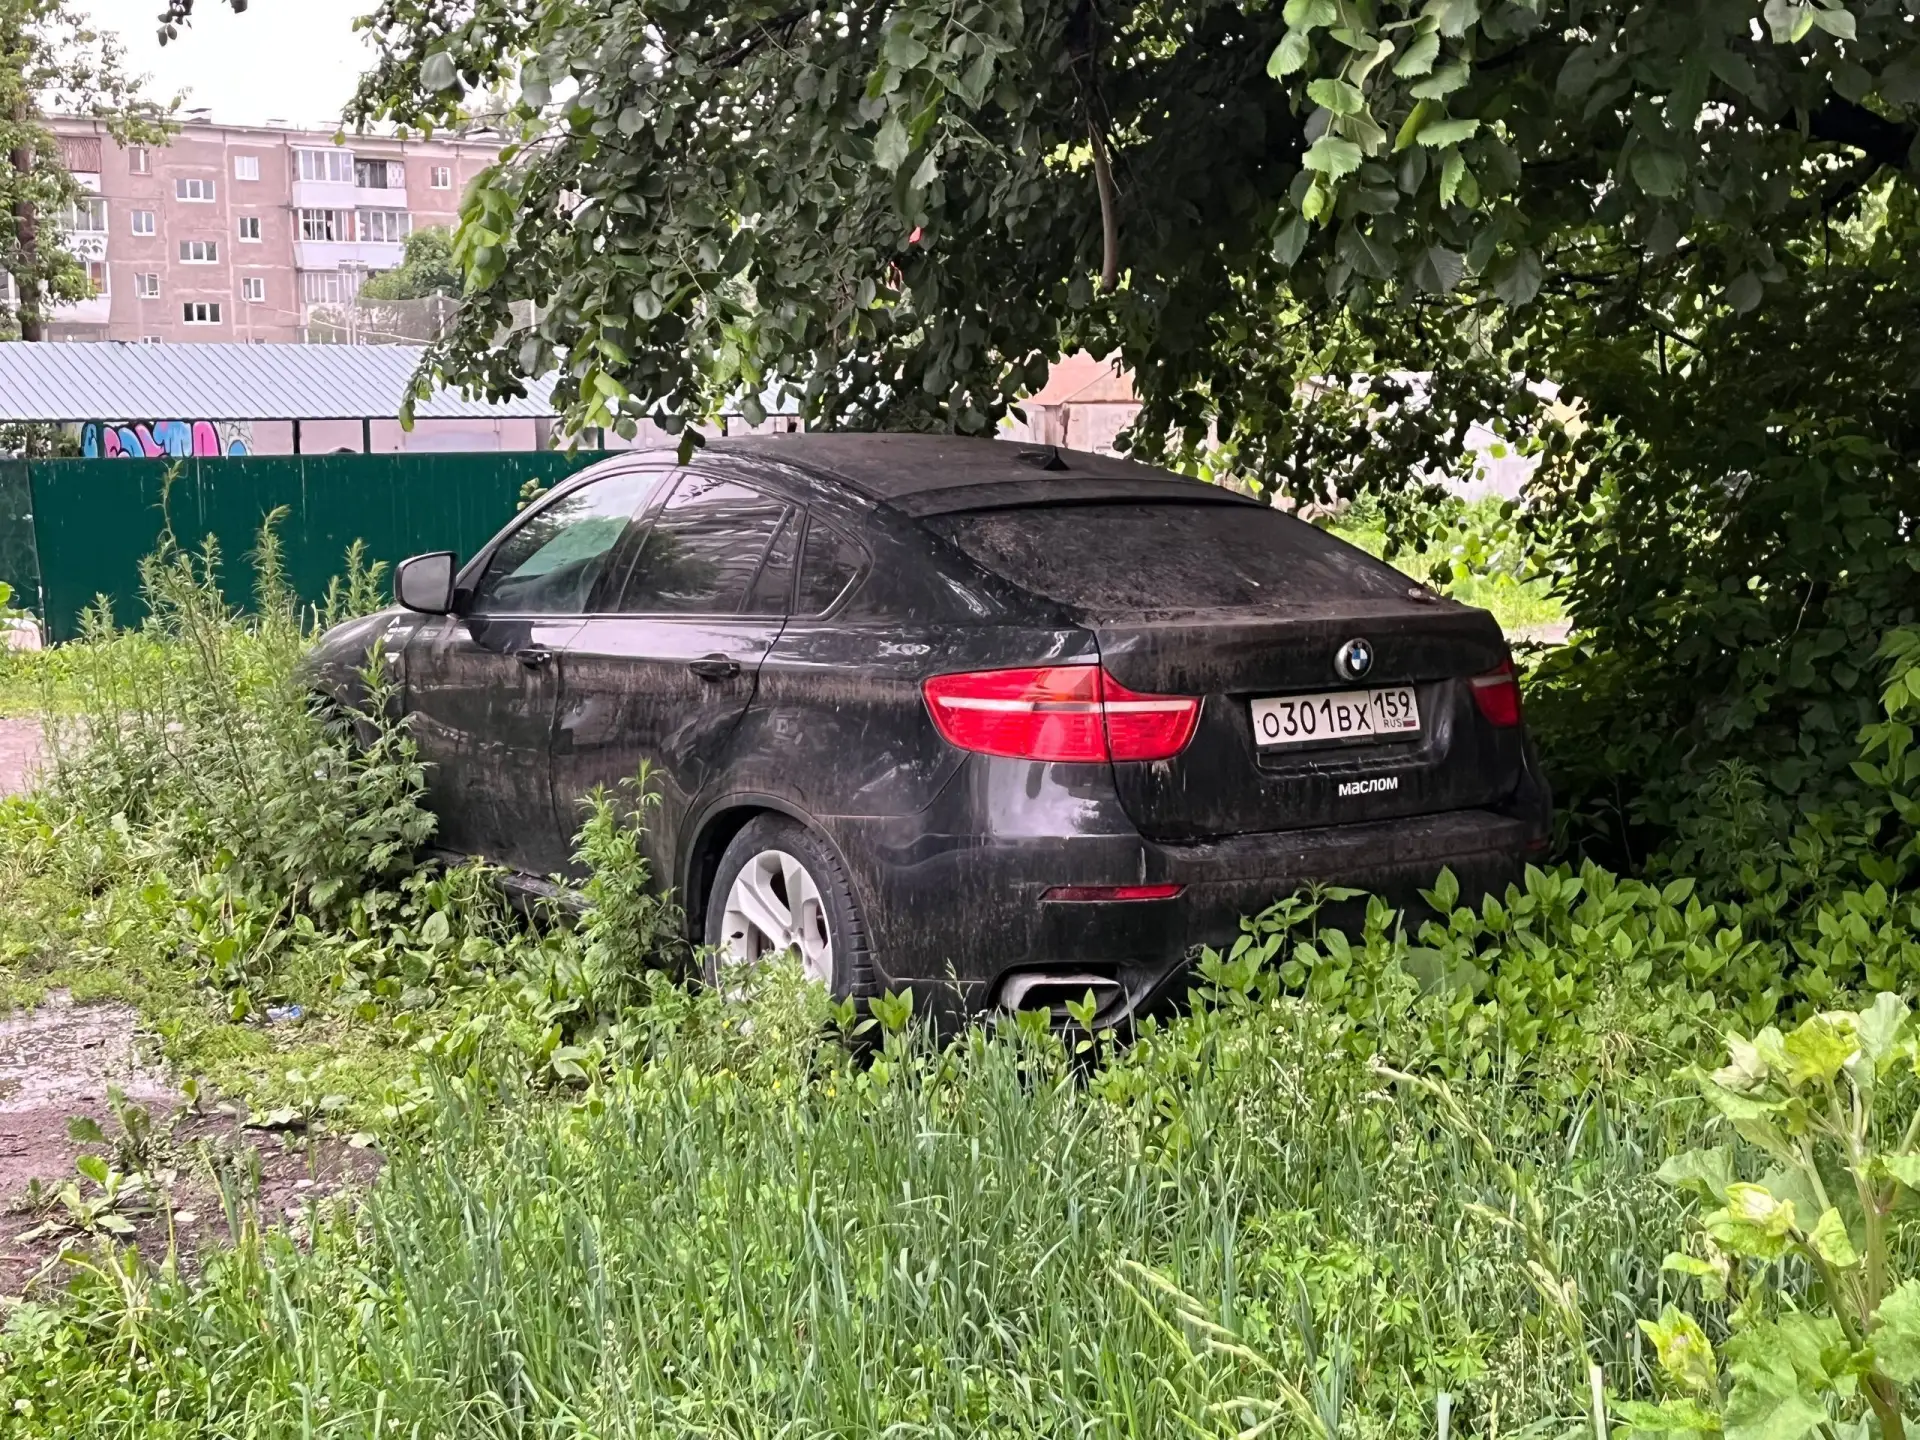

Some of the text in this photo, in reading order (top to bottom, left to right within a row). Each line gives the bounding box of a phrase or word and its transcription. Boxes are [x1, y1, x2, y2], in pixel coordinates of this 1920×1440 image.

[1374, 691, 1410, 719] 159
[1383, 718, 1403, 729] RUS
[1338, 776, 1399, 797] маслом
